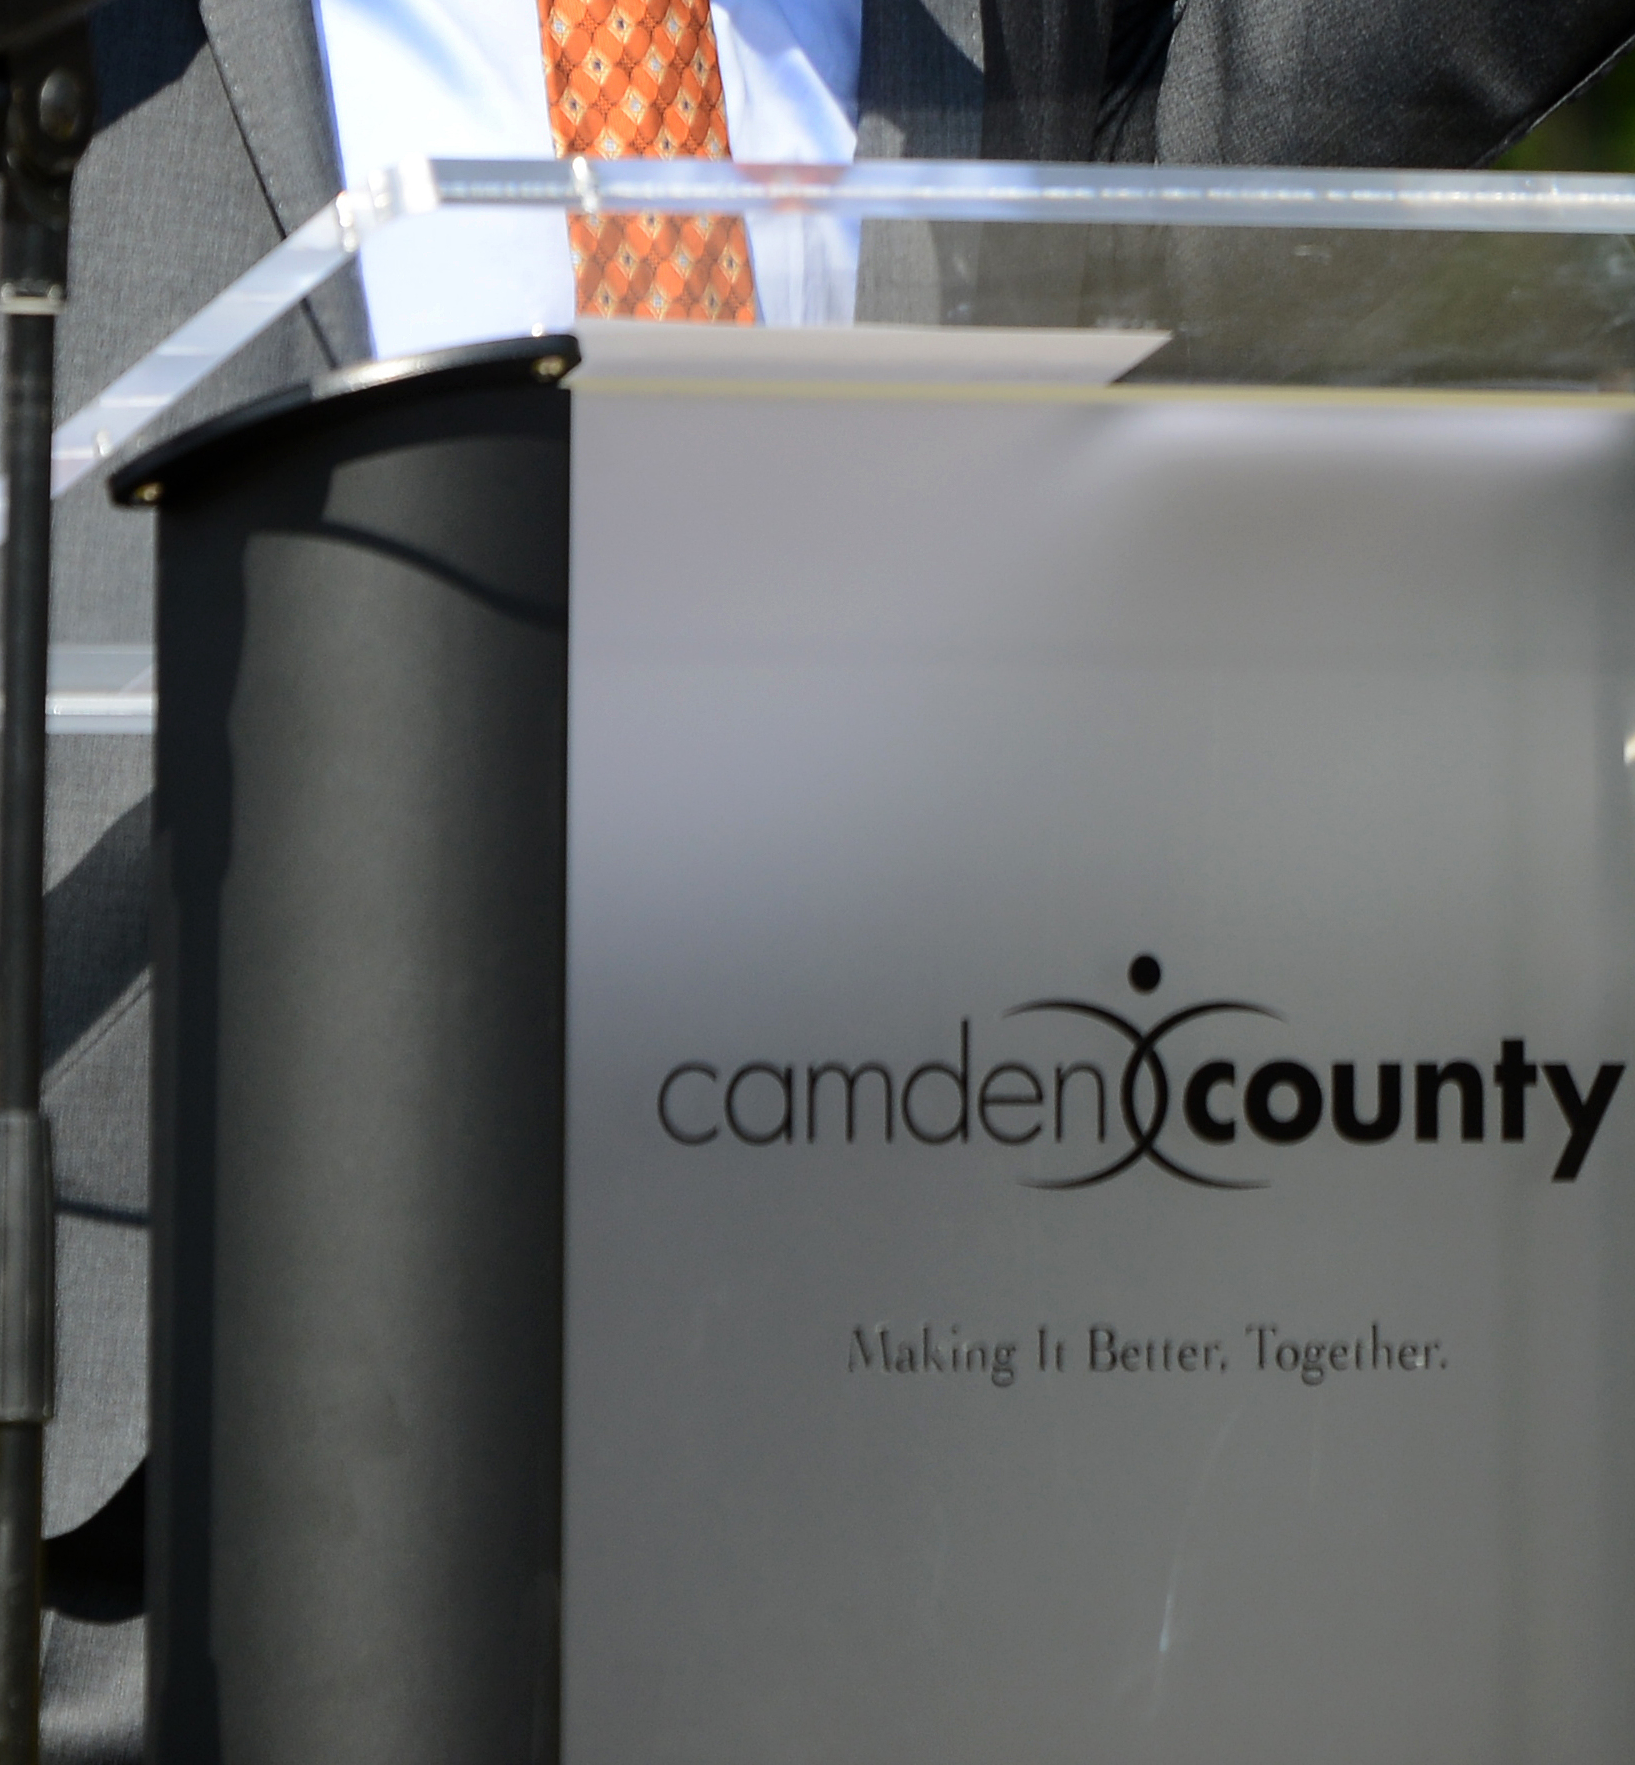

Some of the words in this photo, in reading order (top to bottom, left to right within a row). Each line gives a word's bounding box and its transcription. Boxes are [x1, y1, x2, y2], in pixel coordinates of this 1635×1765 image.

[658, 1018, 1107, 1147] camden
[1184, 1039, 1626, 1184] county
[847, 1324, 1018, 1387] Making
[1037, 1324, 1066, 1372] It
[1245, 1321, 1448, 1387] Together.
